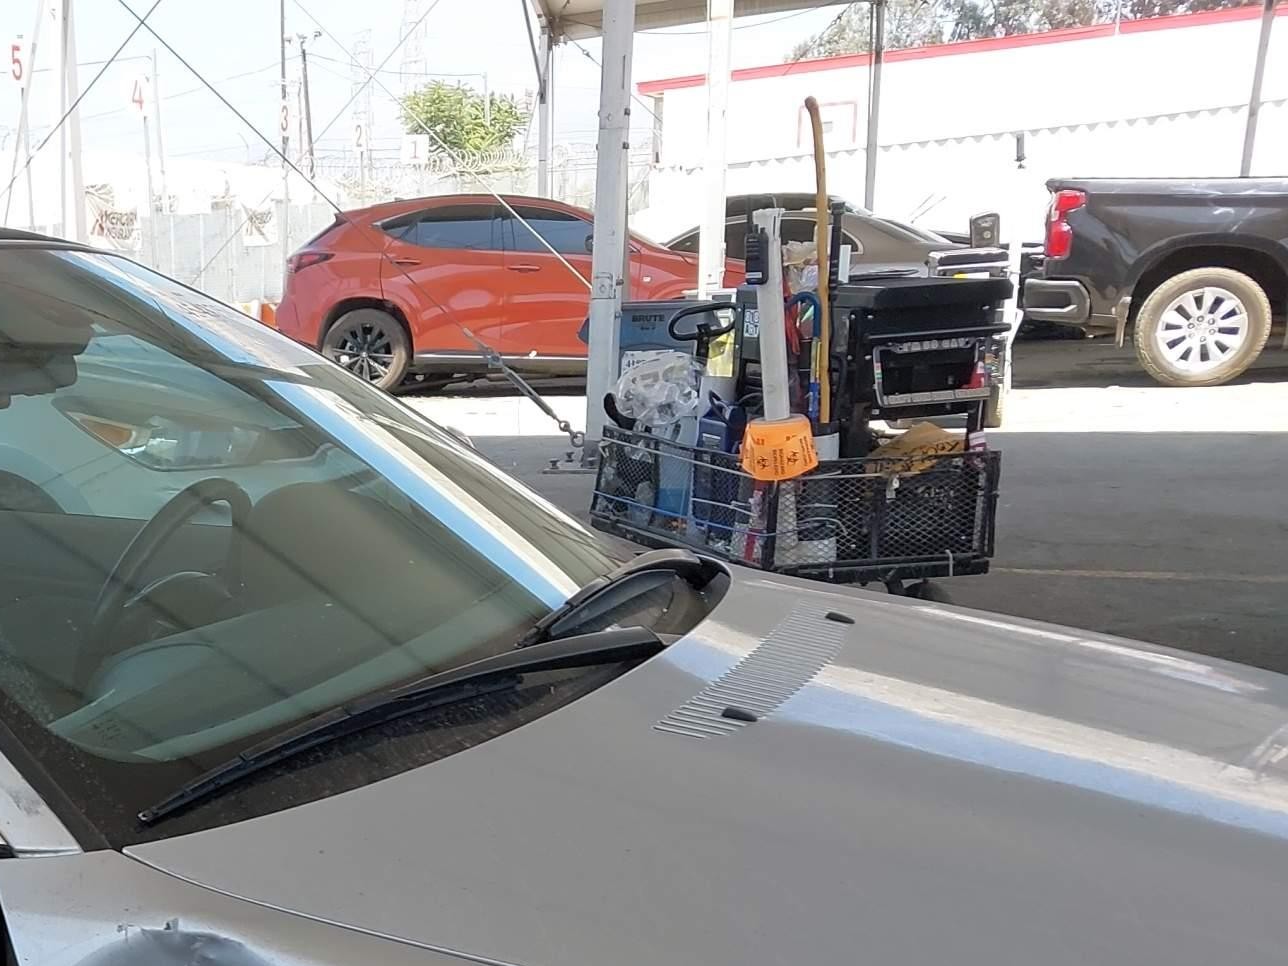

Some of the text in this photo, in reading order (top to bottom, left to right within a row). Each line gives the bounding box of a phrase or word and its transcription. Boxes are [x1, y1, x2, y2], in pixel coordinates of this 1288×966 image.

[11, 44, 23, 81] 5
[132, 79, 144, 111] 4
[280, 104, 289, 132] 3
[355, 124, 362, 148] 2
[631, 314, 666, 323] BRUTE
